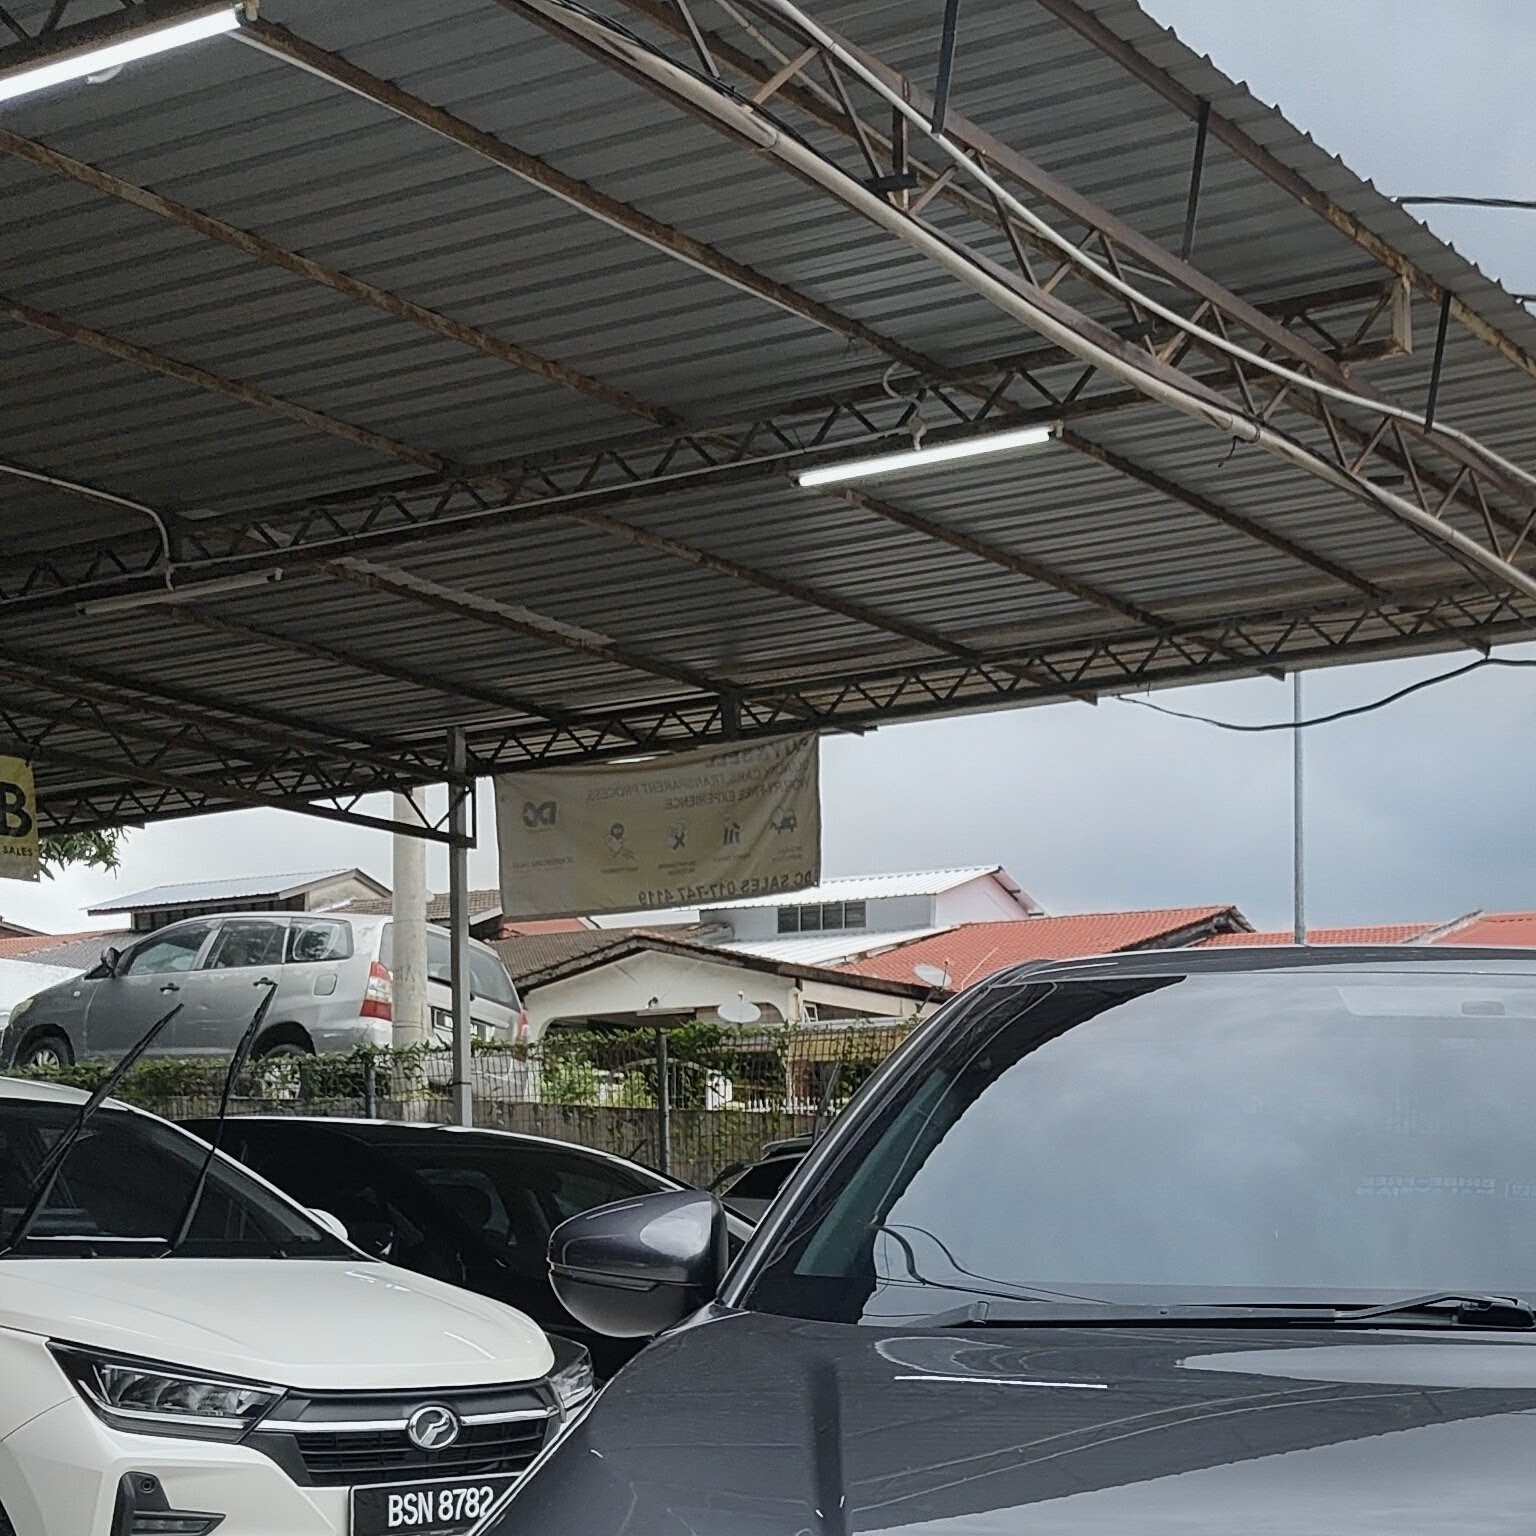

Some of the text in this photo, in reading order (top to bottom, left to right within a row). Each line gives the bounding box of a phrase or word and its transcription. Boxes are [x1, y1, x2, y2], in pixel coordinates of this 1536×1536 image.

[2, 845, 33, 857] SALES
[388, 1485, 494, 1528] BSN 8782
